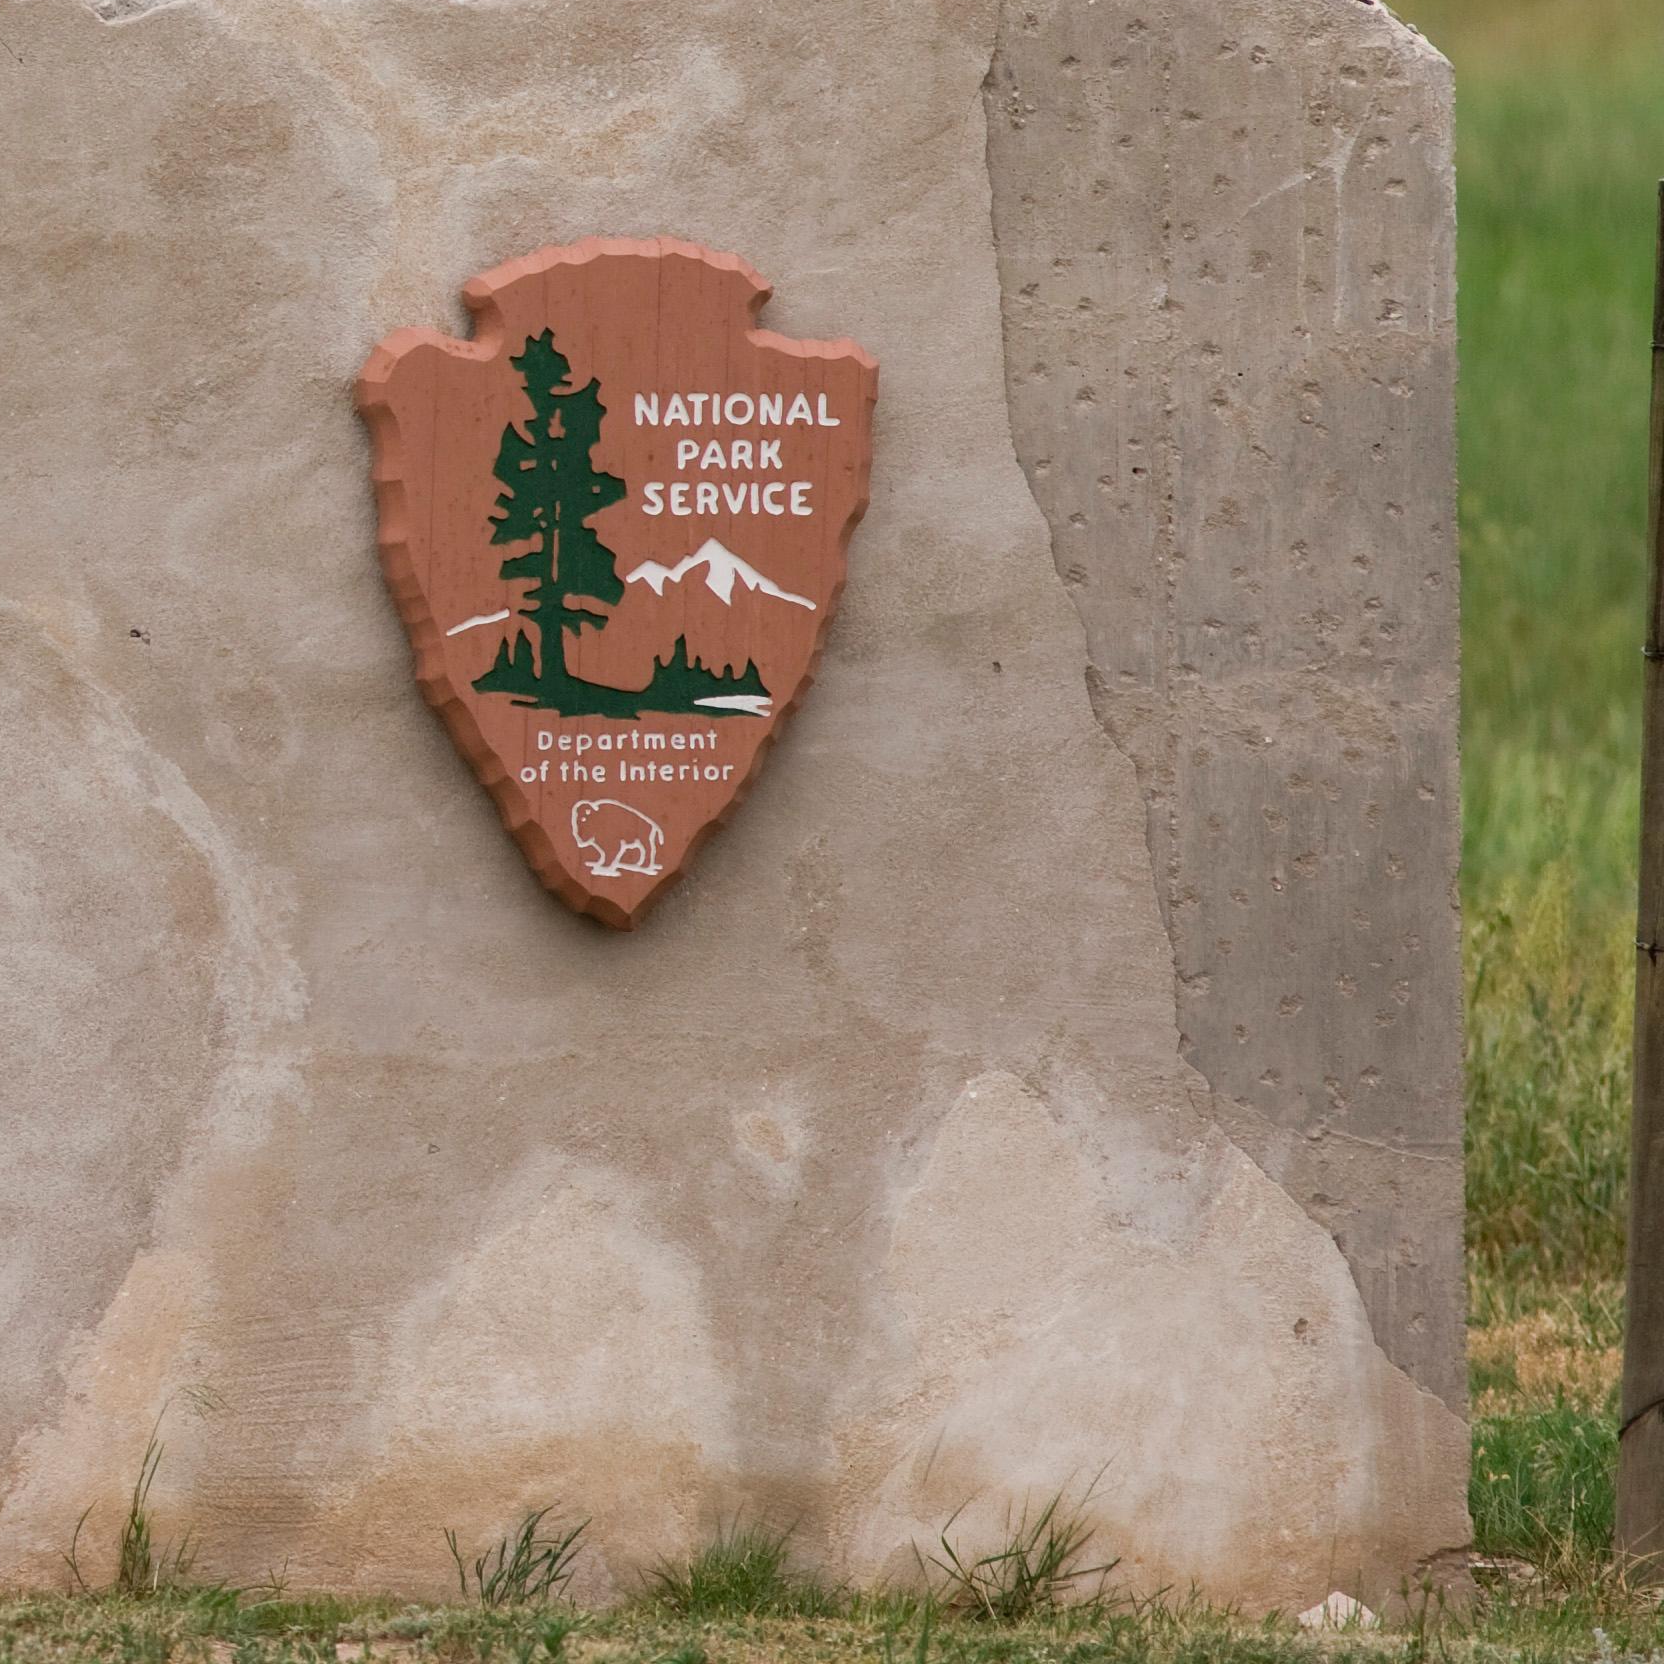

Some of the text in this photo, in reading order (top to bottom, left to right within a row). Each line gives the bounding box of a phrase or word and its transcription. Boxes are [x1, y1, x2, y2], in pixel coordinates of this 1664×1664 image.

[634, 392, 841, 427] NATIONAL
[676, 439, 783, 471] PARK
[641, 481, 813, 516] SERVICE
[537, 729, 718, 756] Department
[520, 759, 734, 783] of the Interior
